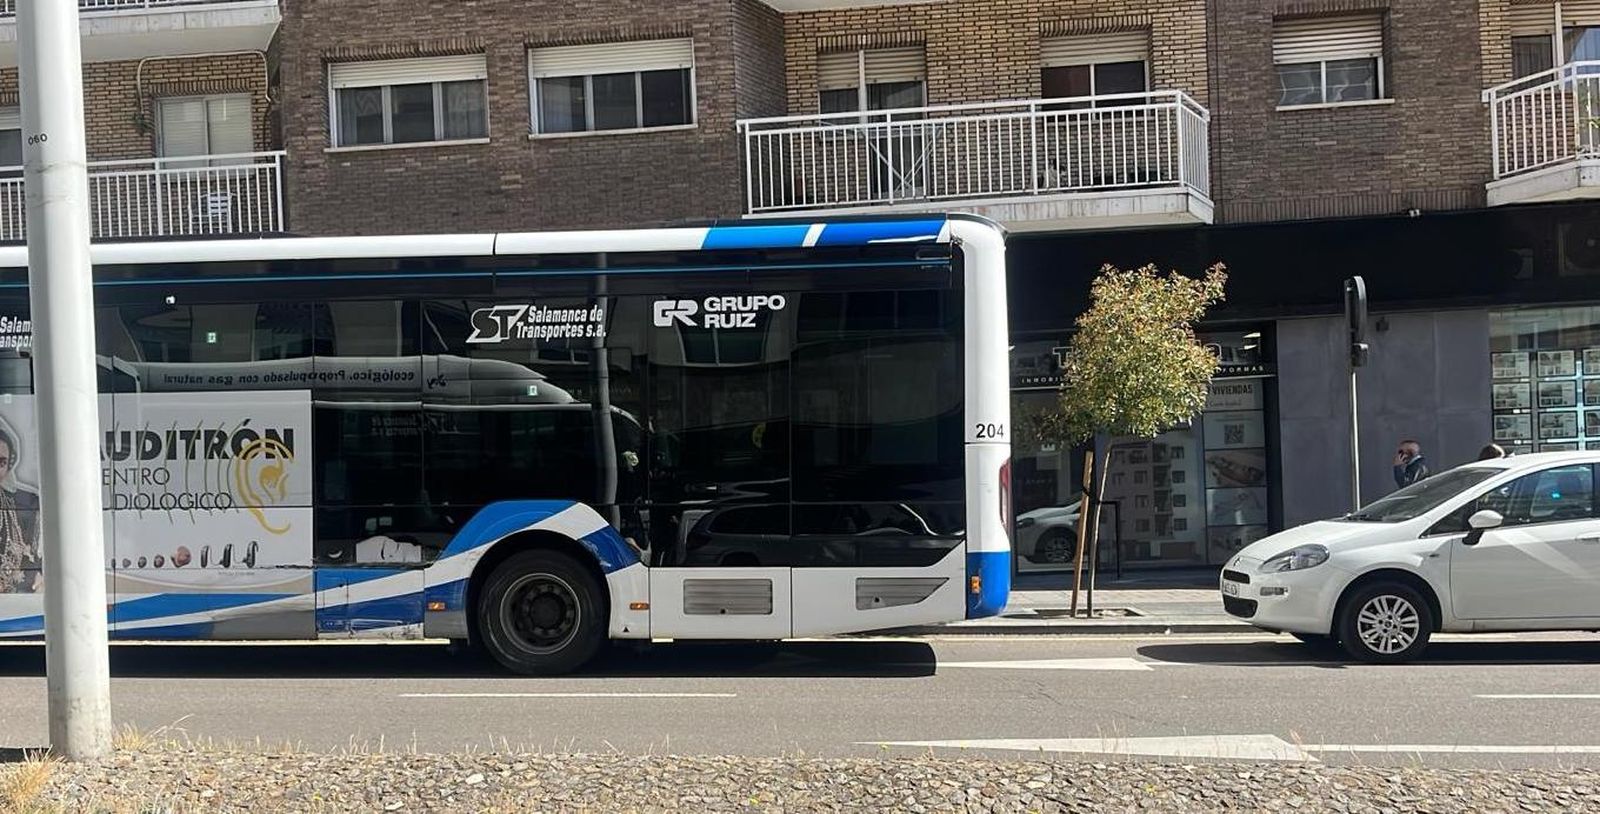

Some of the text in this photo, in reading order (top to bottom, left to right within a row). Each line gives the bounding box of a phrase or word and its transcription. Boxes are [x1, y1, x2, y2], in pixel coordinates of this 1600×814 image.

[703, 294, 786, 312] GRUPO
[527, 304, 603, 323] Salamanca de
[653, 299, 698, 327] GR
[704, 312, 756, 328] RUIZ
[0, 315, 32, 334] Salam
[465, 304, 529, 343] ST
[516, 321, 606, 343] Transportes s.a.
[0, 335, 32, 352] anspor
[100, 418, 295, 461] UDITRÓN
[975, 423, 1004, 439] 204
[102, 467, 170, 485] ENTRO
[102, 492, 232, 510] DIOLOGICO
